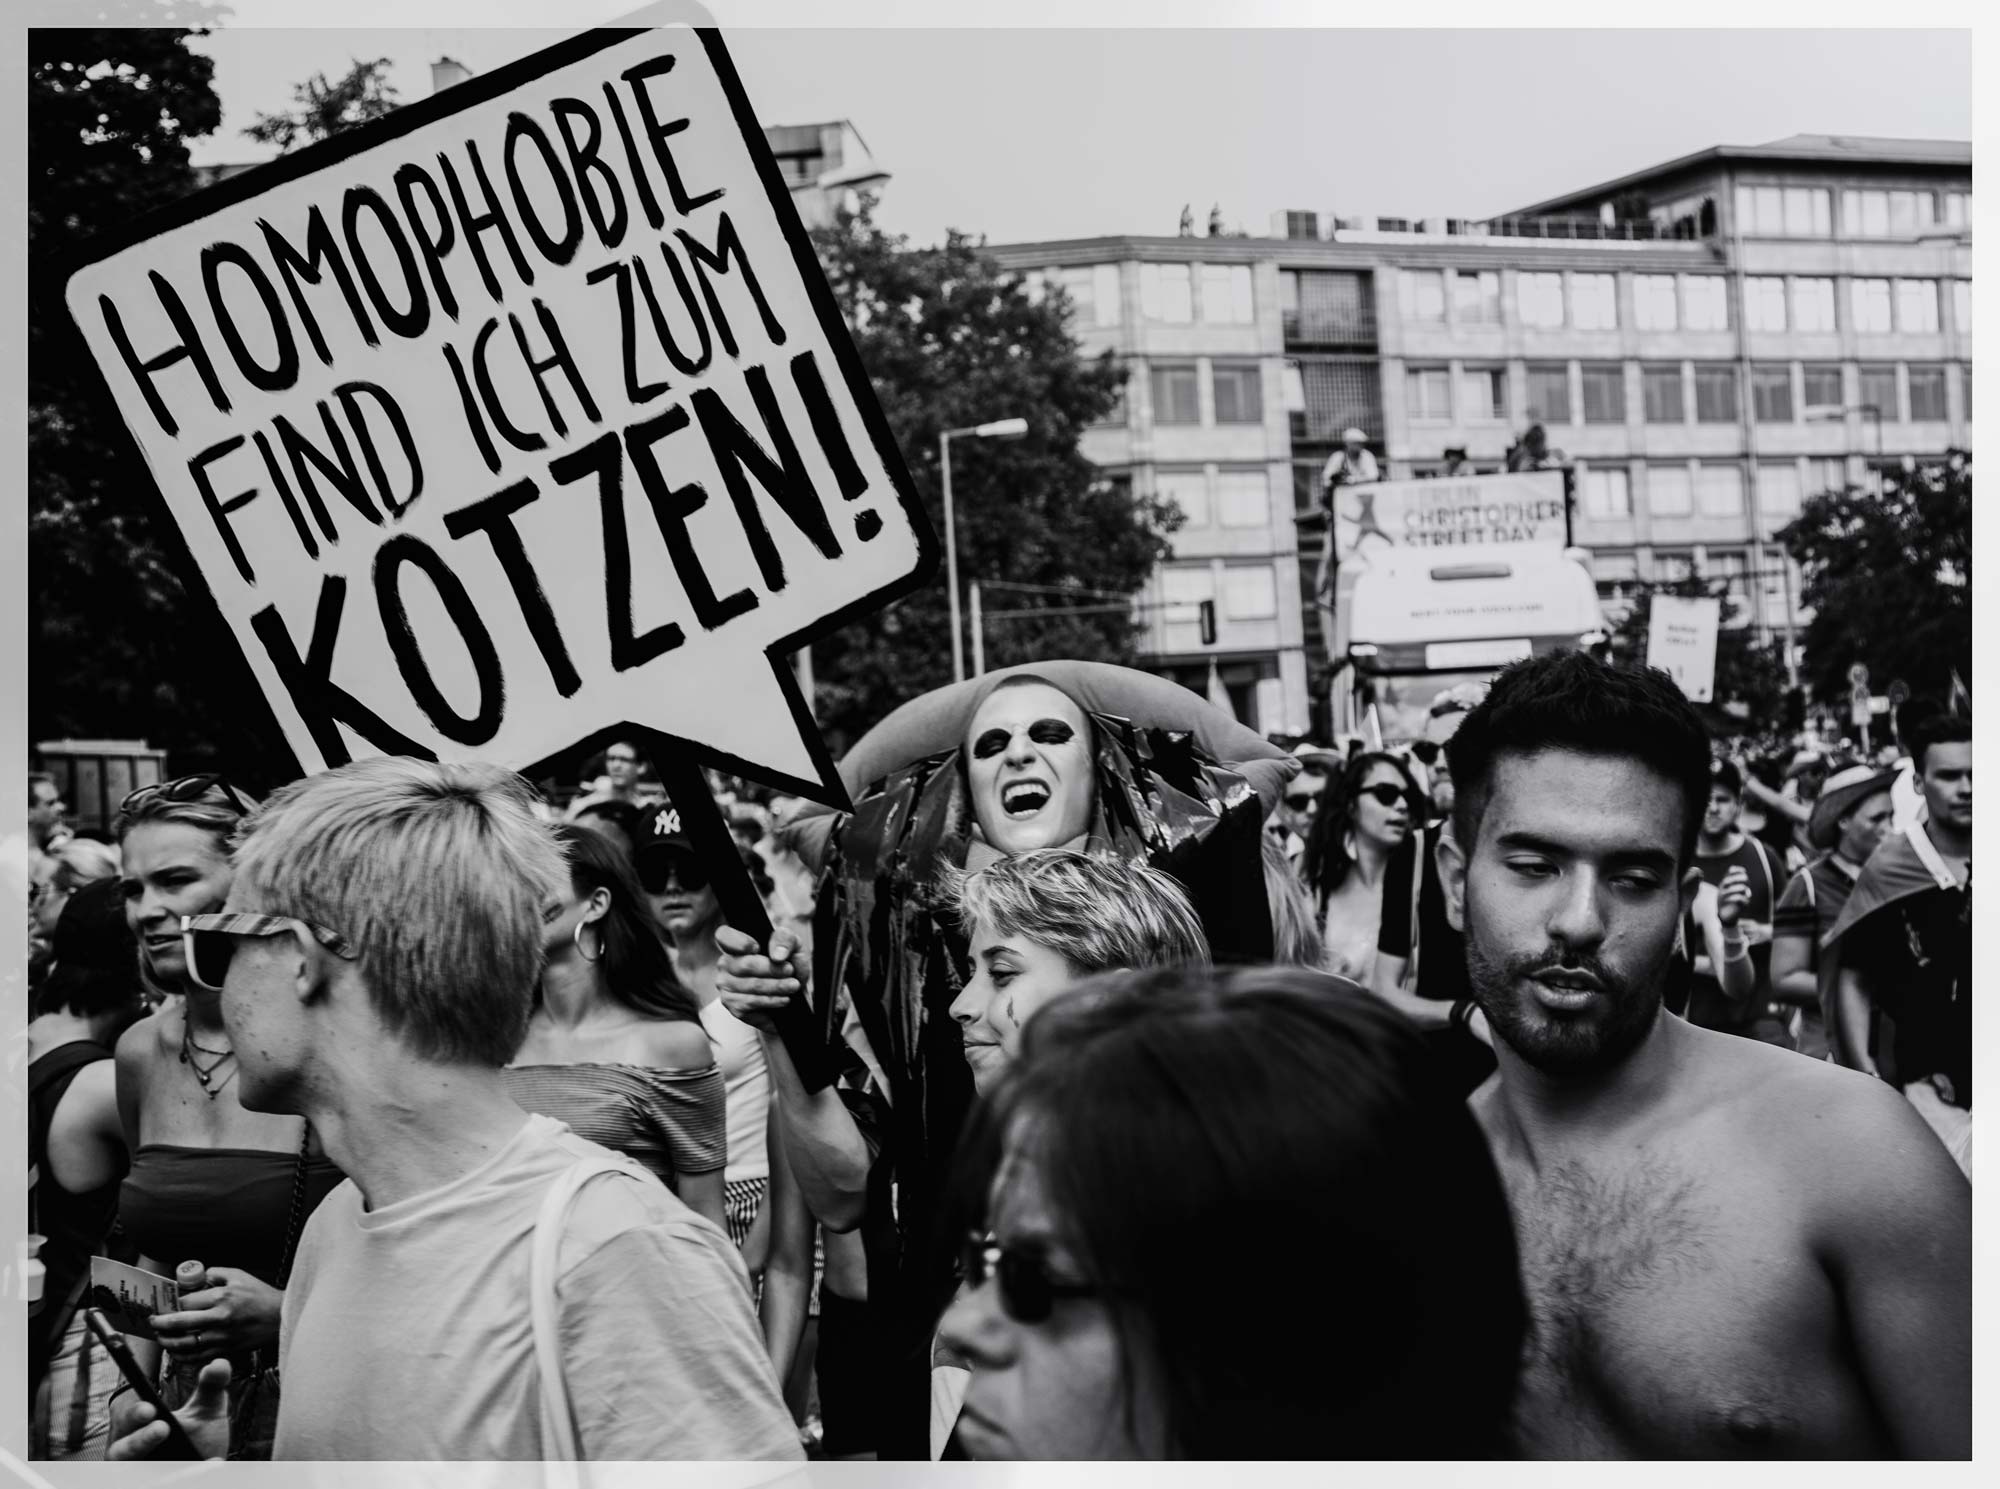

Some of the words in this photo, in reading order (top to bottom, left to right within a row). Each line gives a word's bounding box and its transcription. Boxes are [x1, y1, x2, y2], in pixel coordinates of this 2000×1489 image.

[98, 55, 724, 438] HOMOPHOBIE
[187, 382, 423, 585] FIND
[442, 298, 602, 475] ICH
[586, 211, 786, 404] ZUM
[250, 350, 883, 770] KOTZEN!
[1404, 500, 1564, 528] CHRISTOPHER
[1405, 528, 1484, 547] STREET
[1494, 524, 1538, 543] DAY
